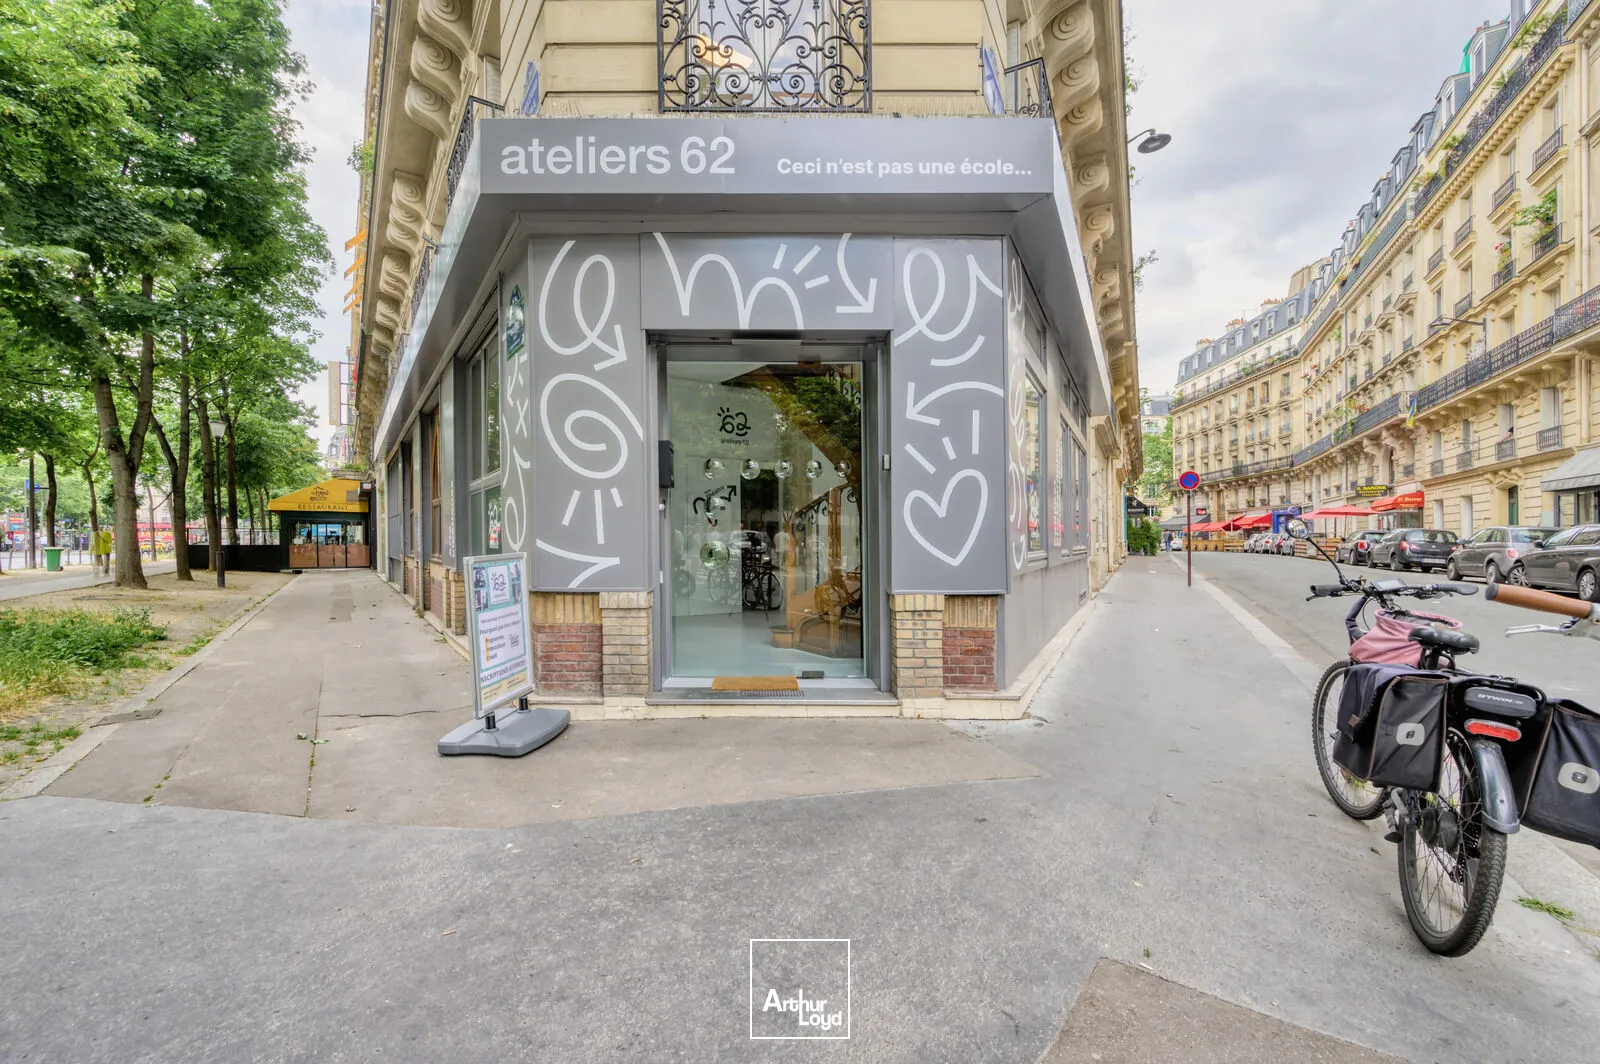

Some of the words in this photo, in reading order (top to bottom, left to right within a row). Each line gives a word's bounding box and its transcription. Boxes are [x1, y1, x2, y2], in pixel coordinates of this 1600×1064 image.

[500, 135, 671, 175] ateliers
[680, 135, 735, 175] 62
[777, 157, 821, 175] Ceci
[878, 161, 914, 178] pas
[919, 161, 956, 175] une
[297, 503, 349, 511] RESTAURANT
